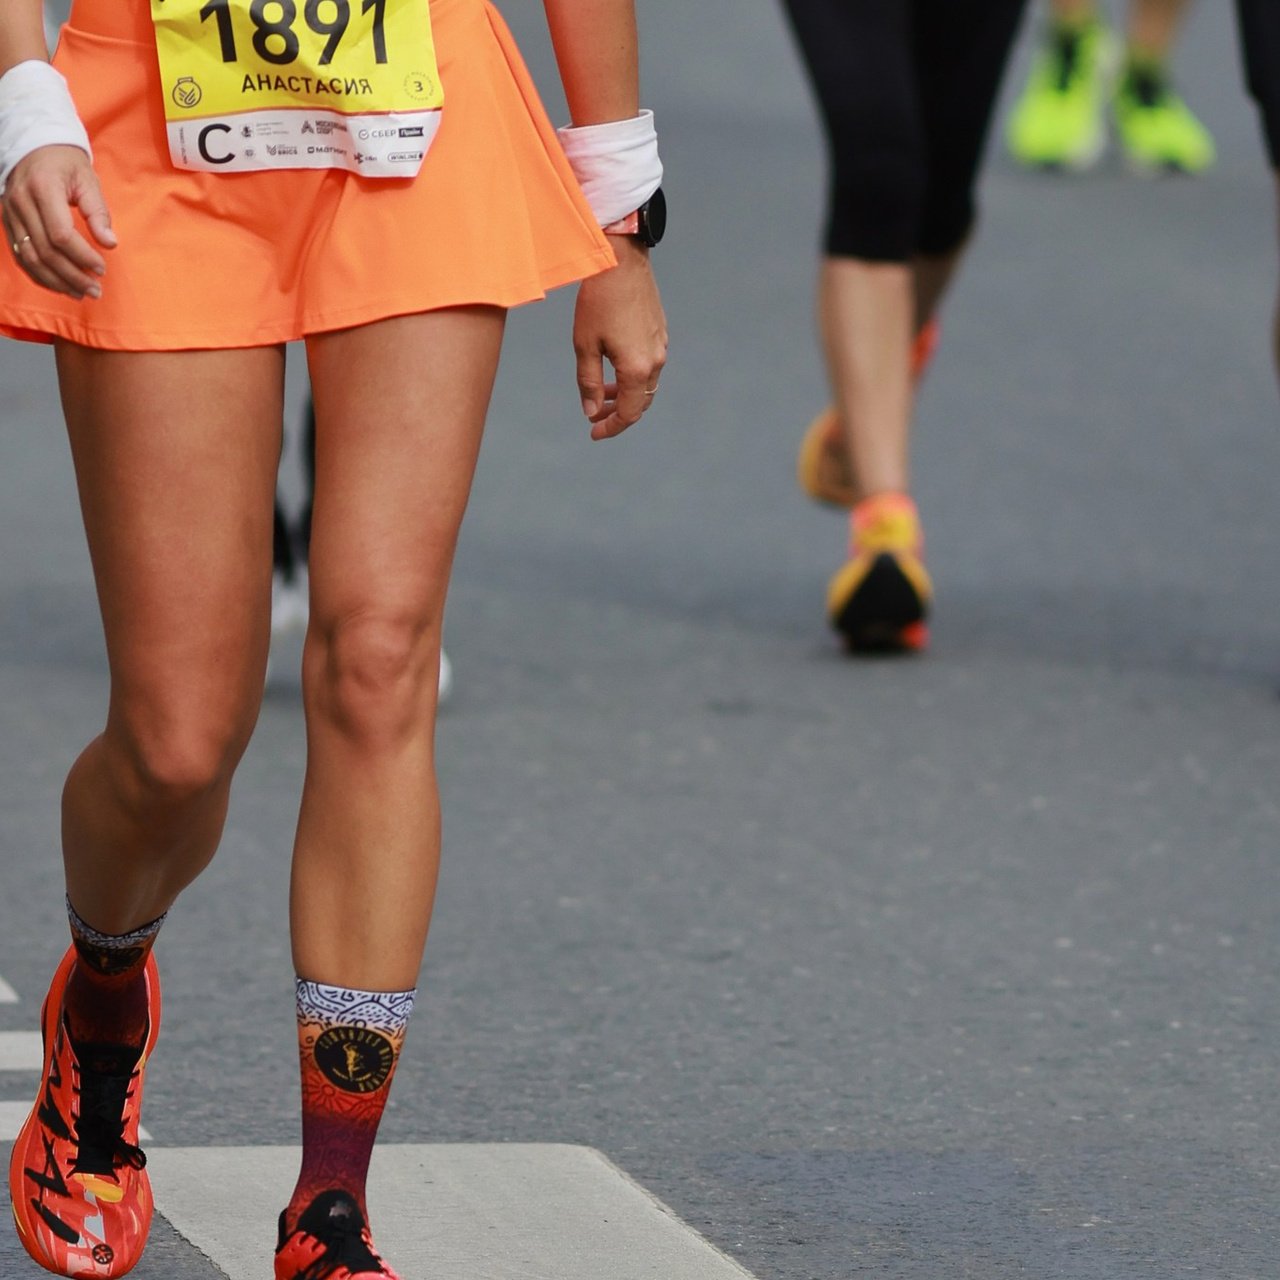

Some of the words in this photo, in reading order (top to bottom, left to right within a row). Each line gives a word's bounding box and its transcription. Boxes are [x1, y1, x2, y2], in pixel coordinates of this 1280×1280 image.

[241, 74, 373, 96] АНАСТАСИЯ
[413, 81, 423, 92] 3
[371, 129, 397, 138] СБЕР
